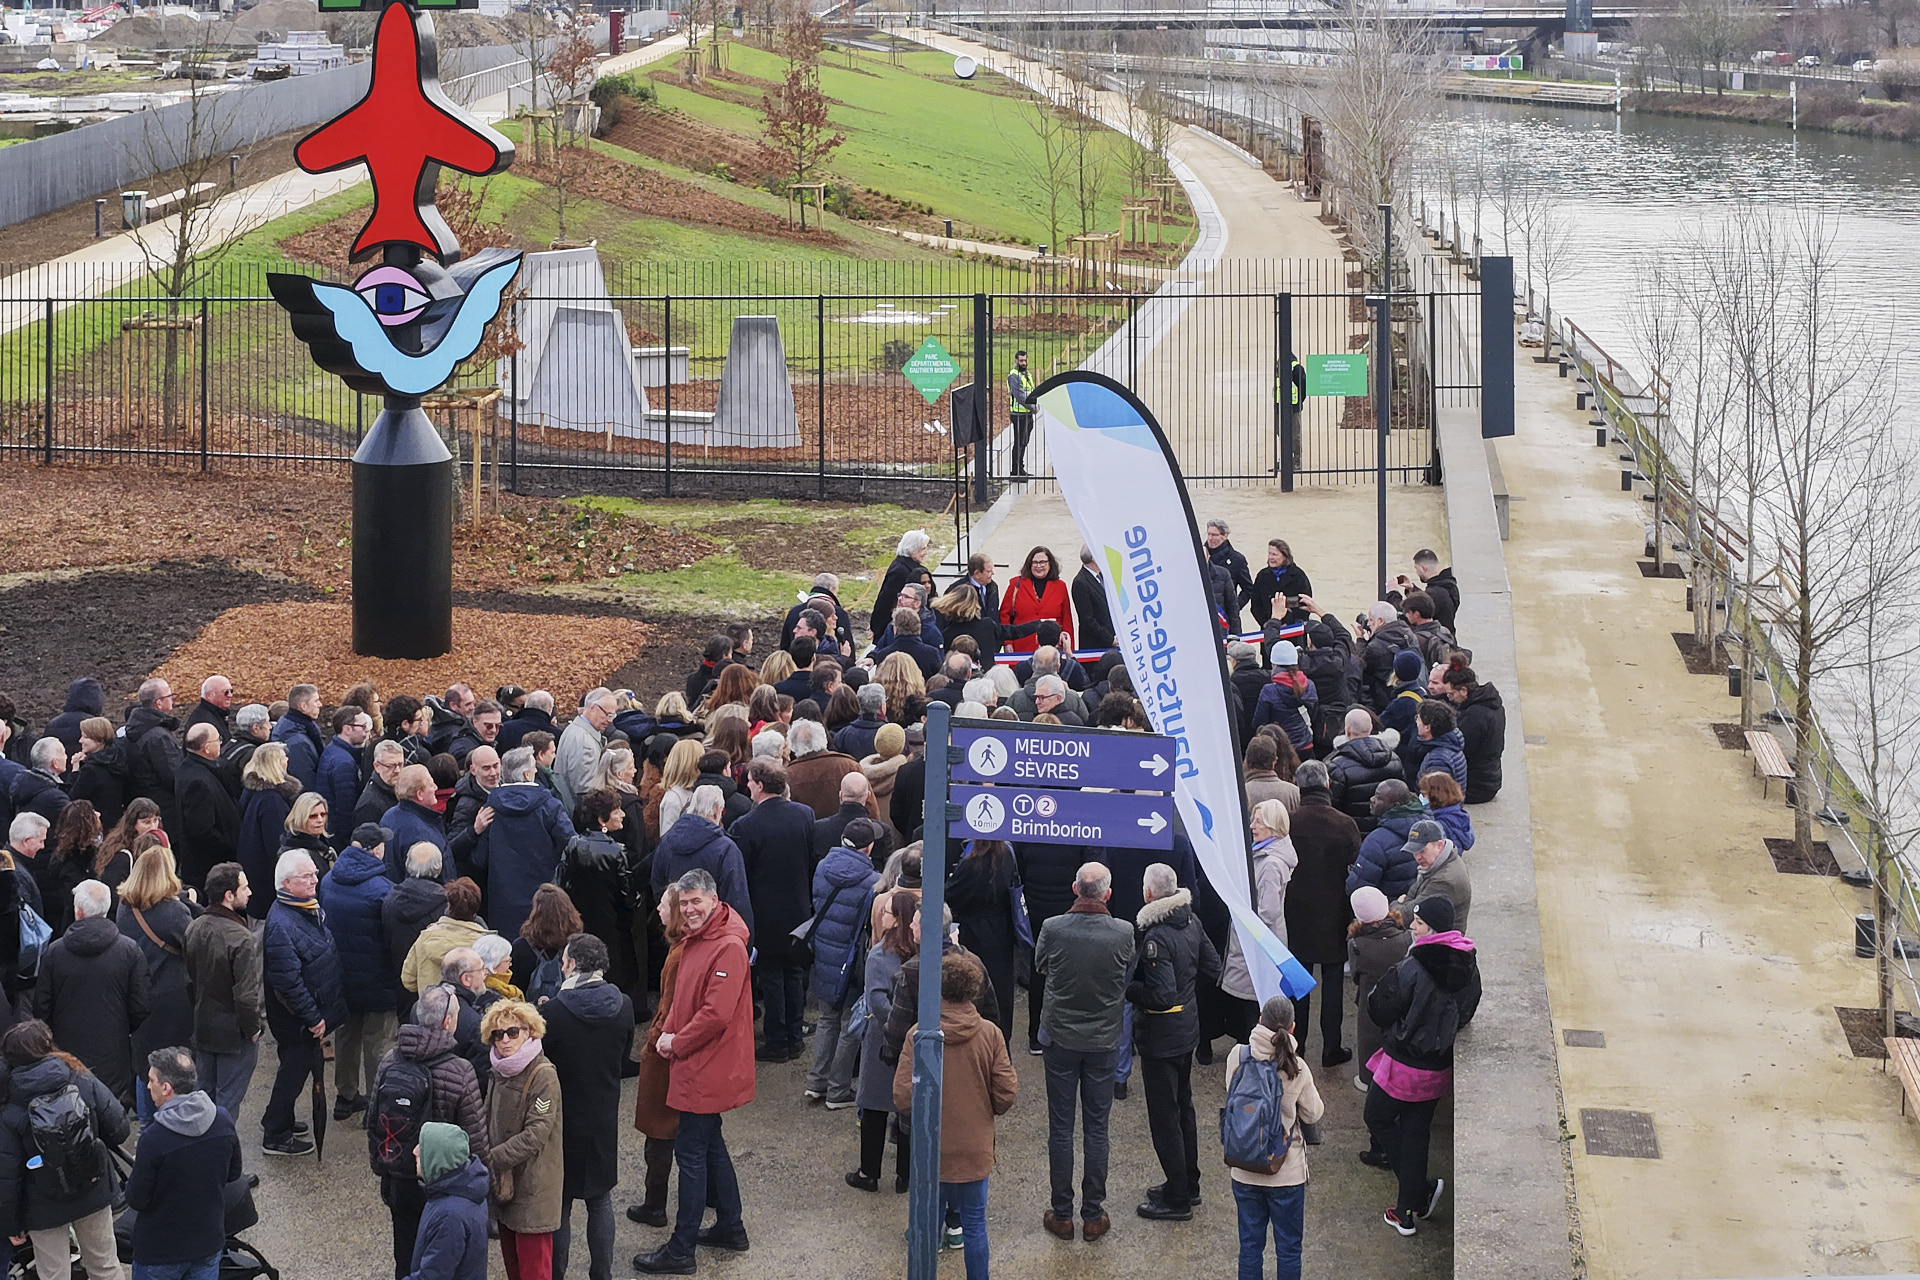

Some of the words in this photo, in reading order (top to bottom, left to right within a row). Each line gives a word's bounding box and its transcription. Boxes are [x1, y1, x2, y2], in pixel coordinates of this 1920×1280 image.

[1015, 738, 1090, 757] MEUDON
[1014, 758, 1079, 779] SÈVRES
[1011, 818, 1102, 839] Brimborion
